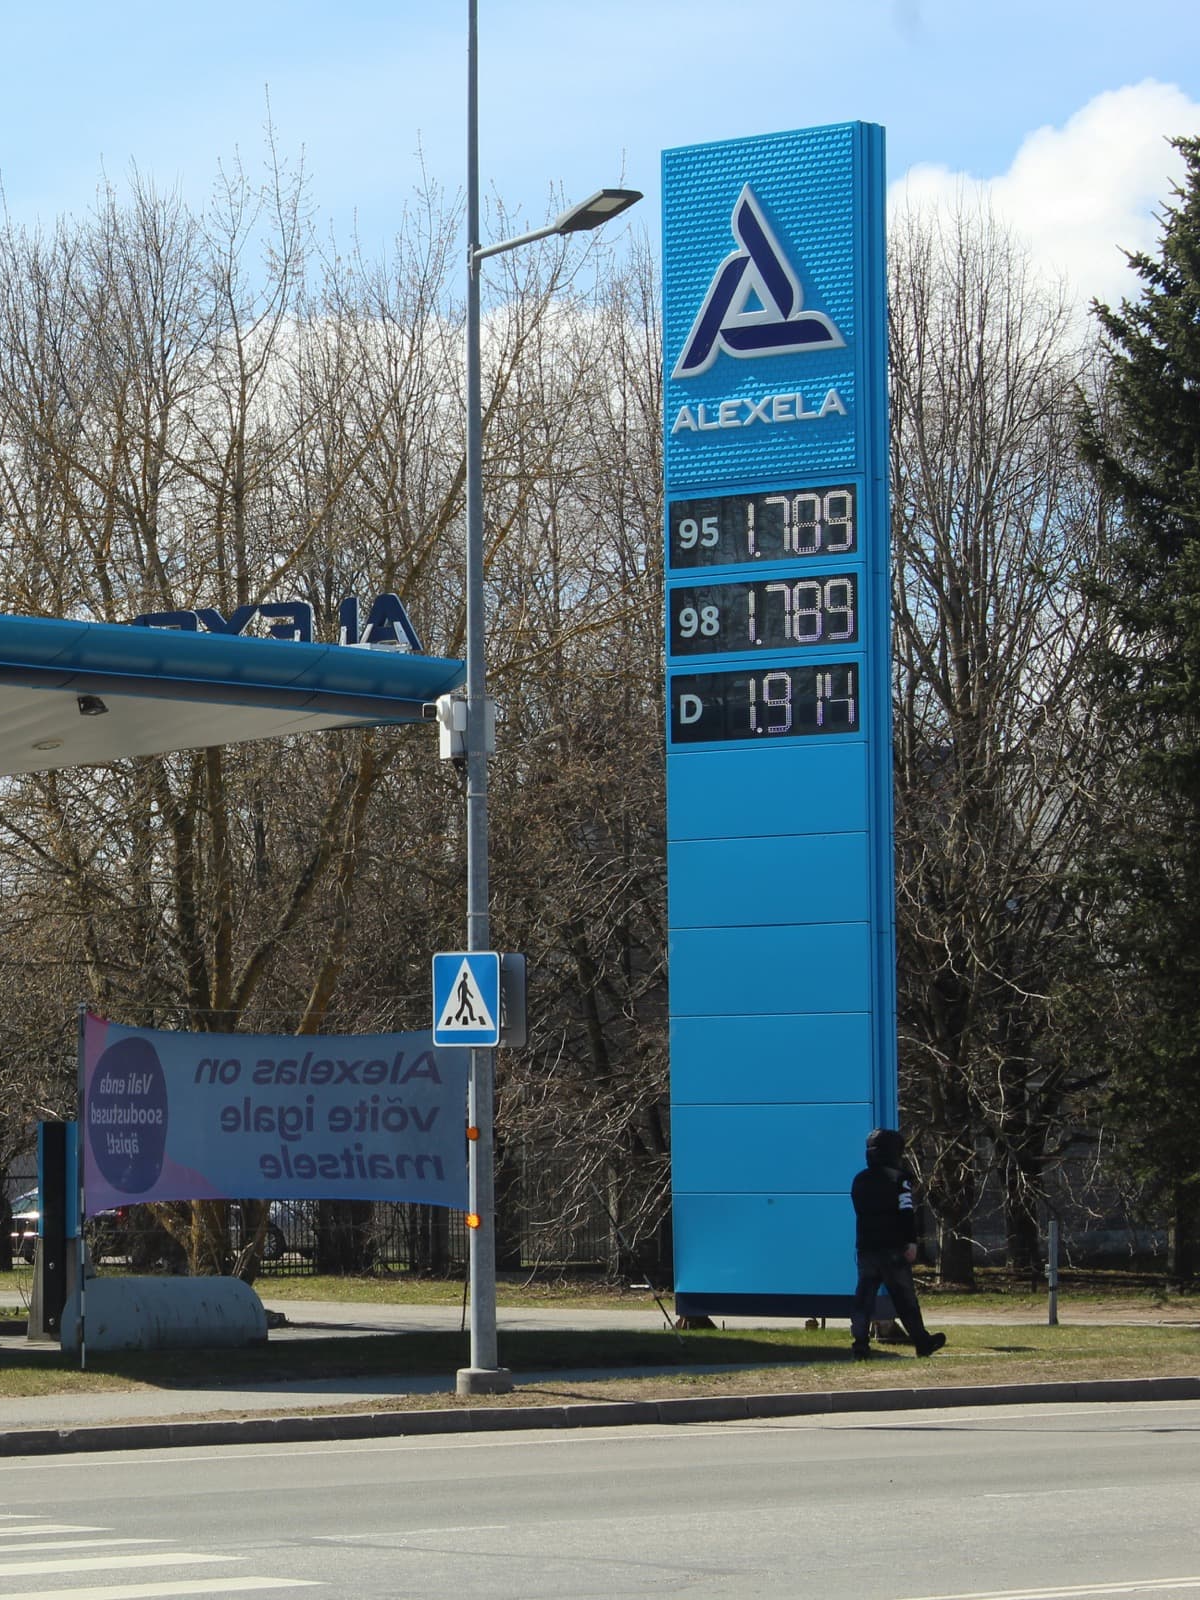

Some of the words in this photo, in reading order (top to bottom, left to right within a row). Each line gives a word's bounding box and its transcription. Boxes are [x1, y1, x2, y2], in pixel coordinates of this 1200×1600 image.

[671, 388, 847, 435] ALEXELA
[678, 516, 719, 550] 95
[678, 605, 720, 638] 98
[748, 578, 854, 645] 1.789
[679, 694, 703, 725] D
[749, 671, 856, 734] 1.914
